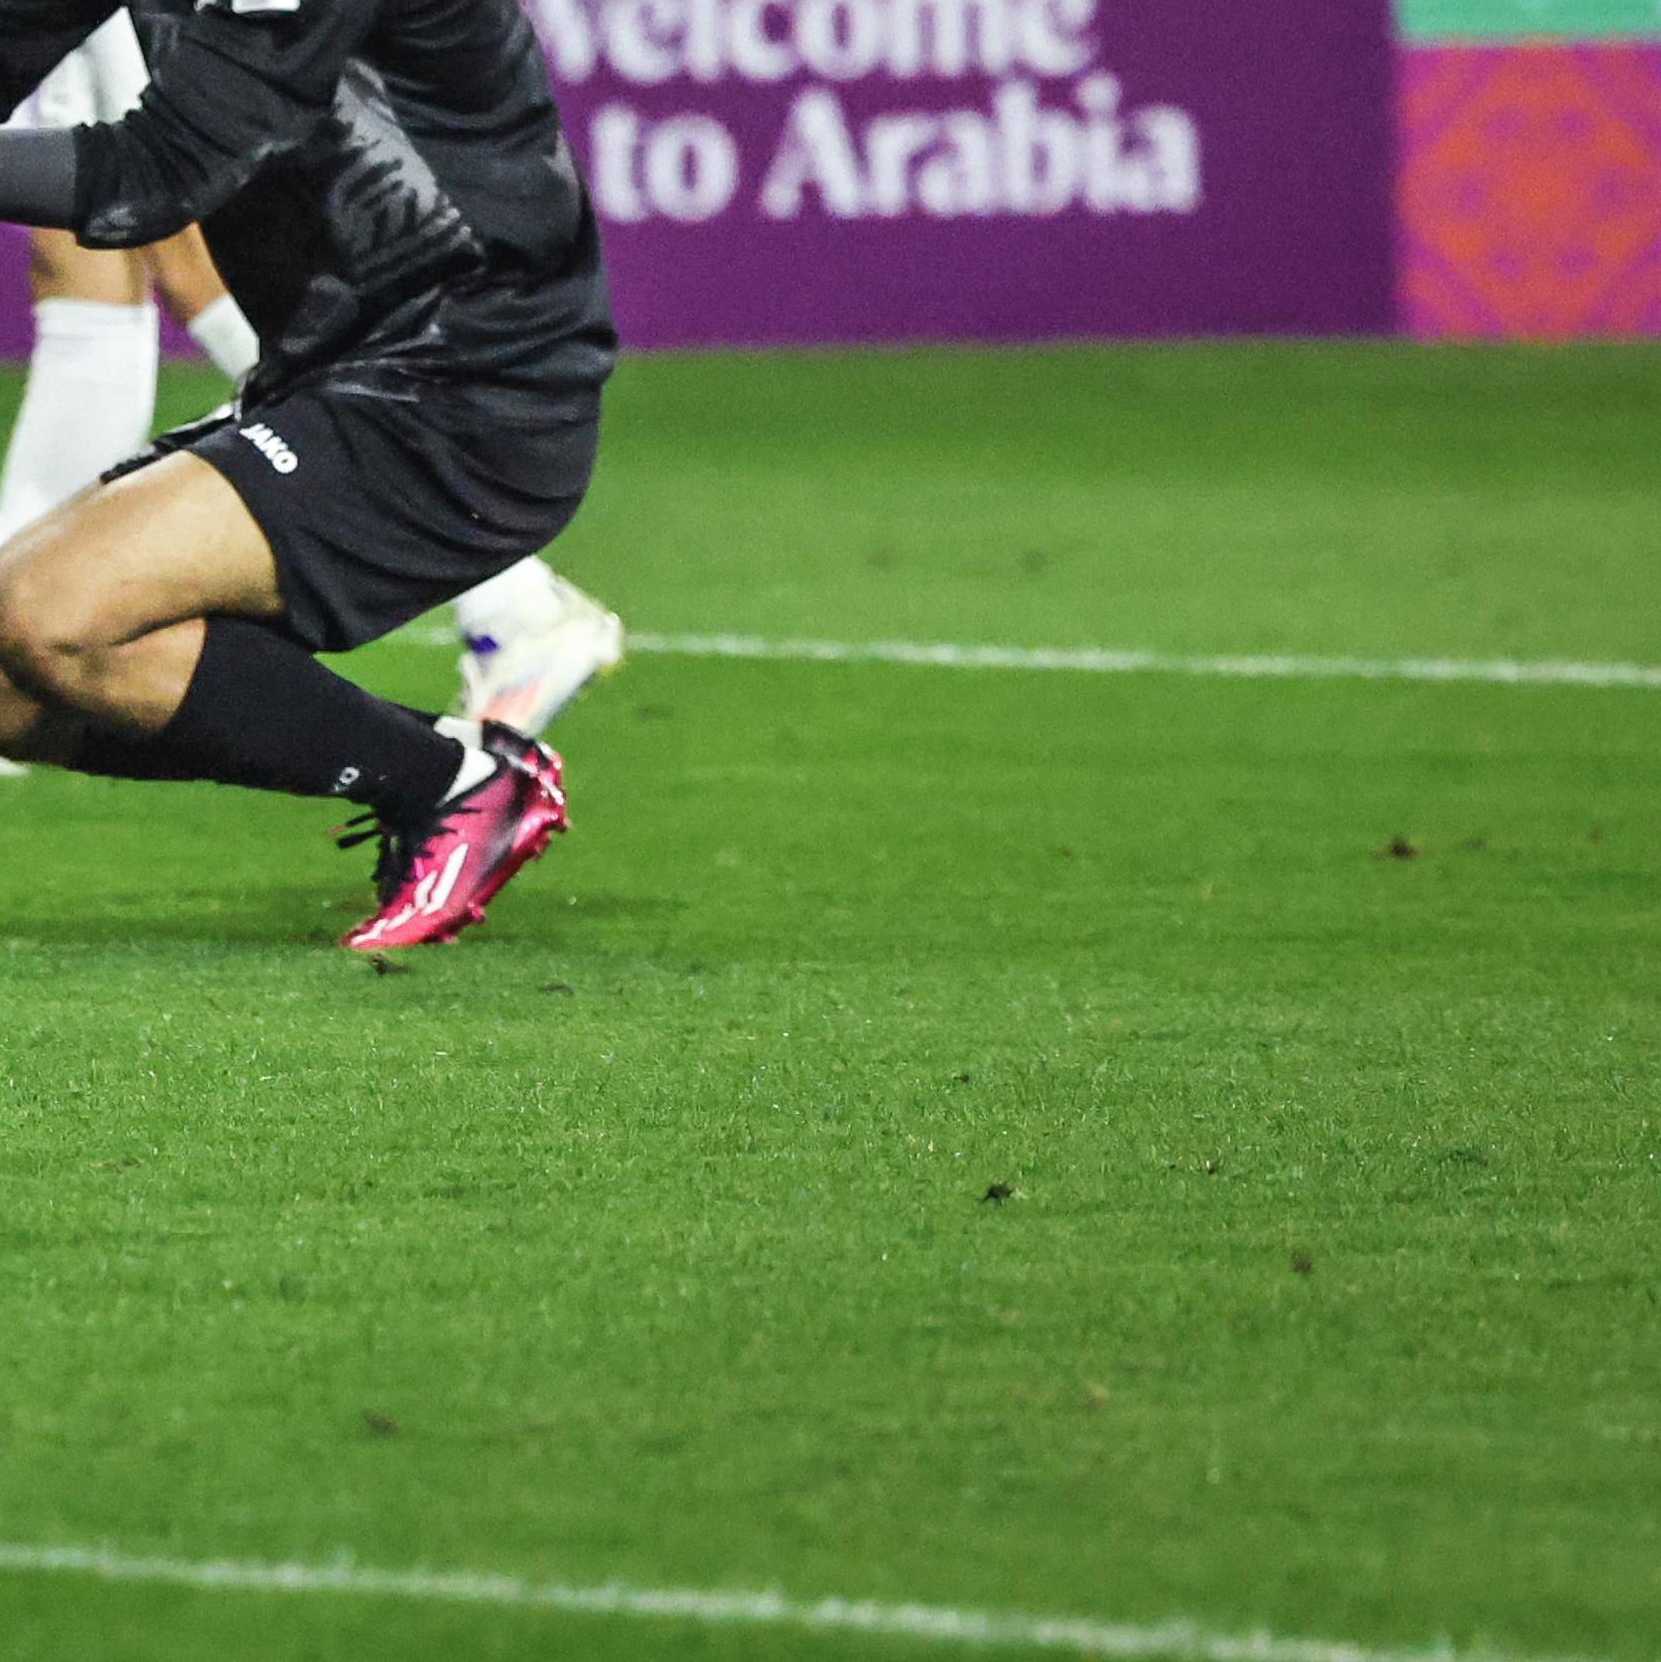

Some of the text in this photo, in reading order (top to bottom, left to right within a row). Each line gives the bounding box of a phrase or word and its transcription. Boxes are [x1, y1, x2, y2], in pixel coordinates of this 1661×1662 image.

[589, 70, 1202, 223] to Arabia
[239, 422, 298, 474] JAKO
